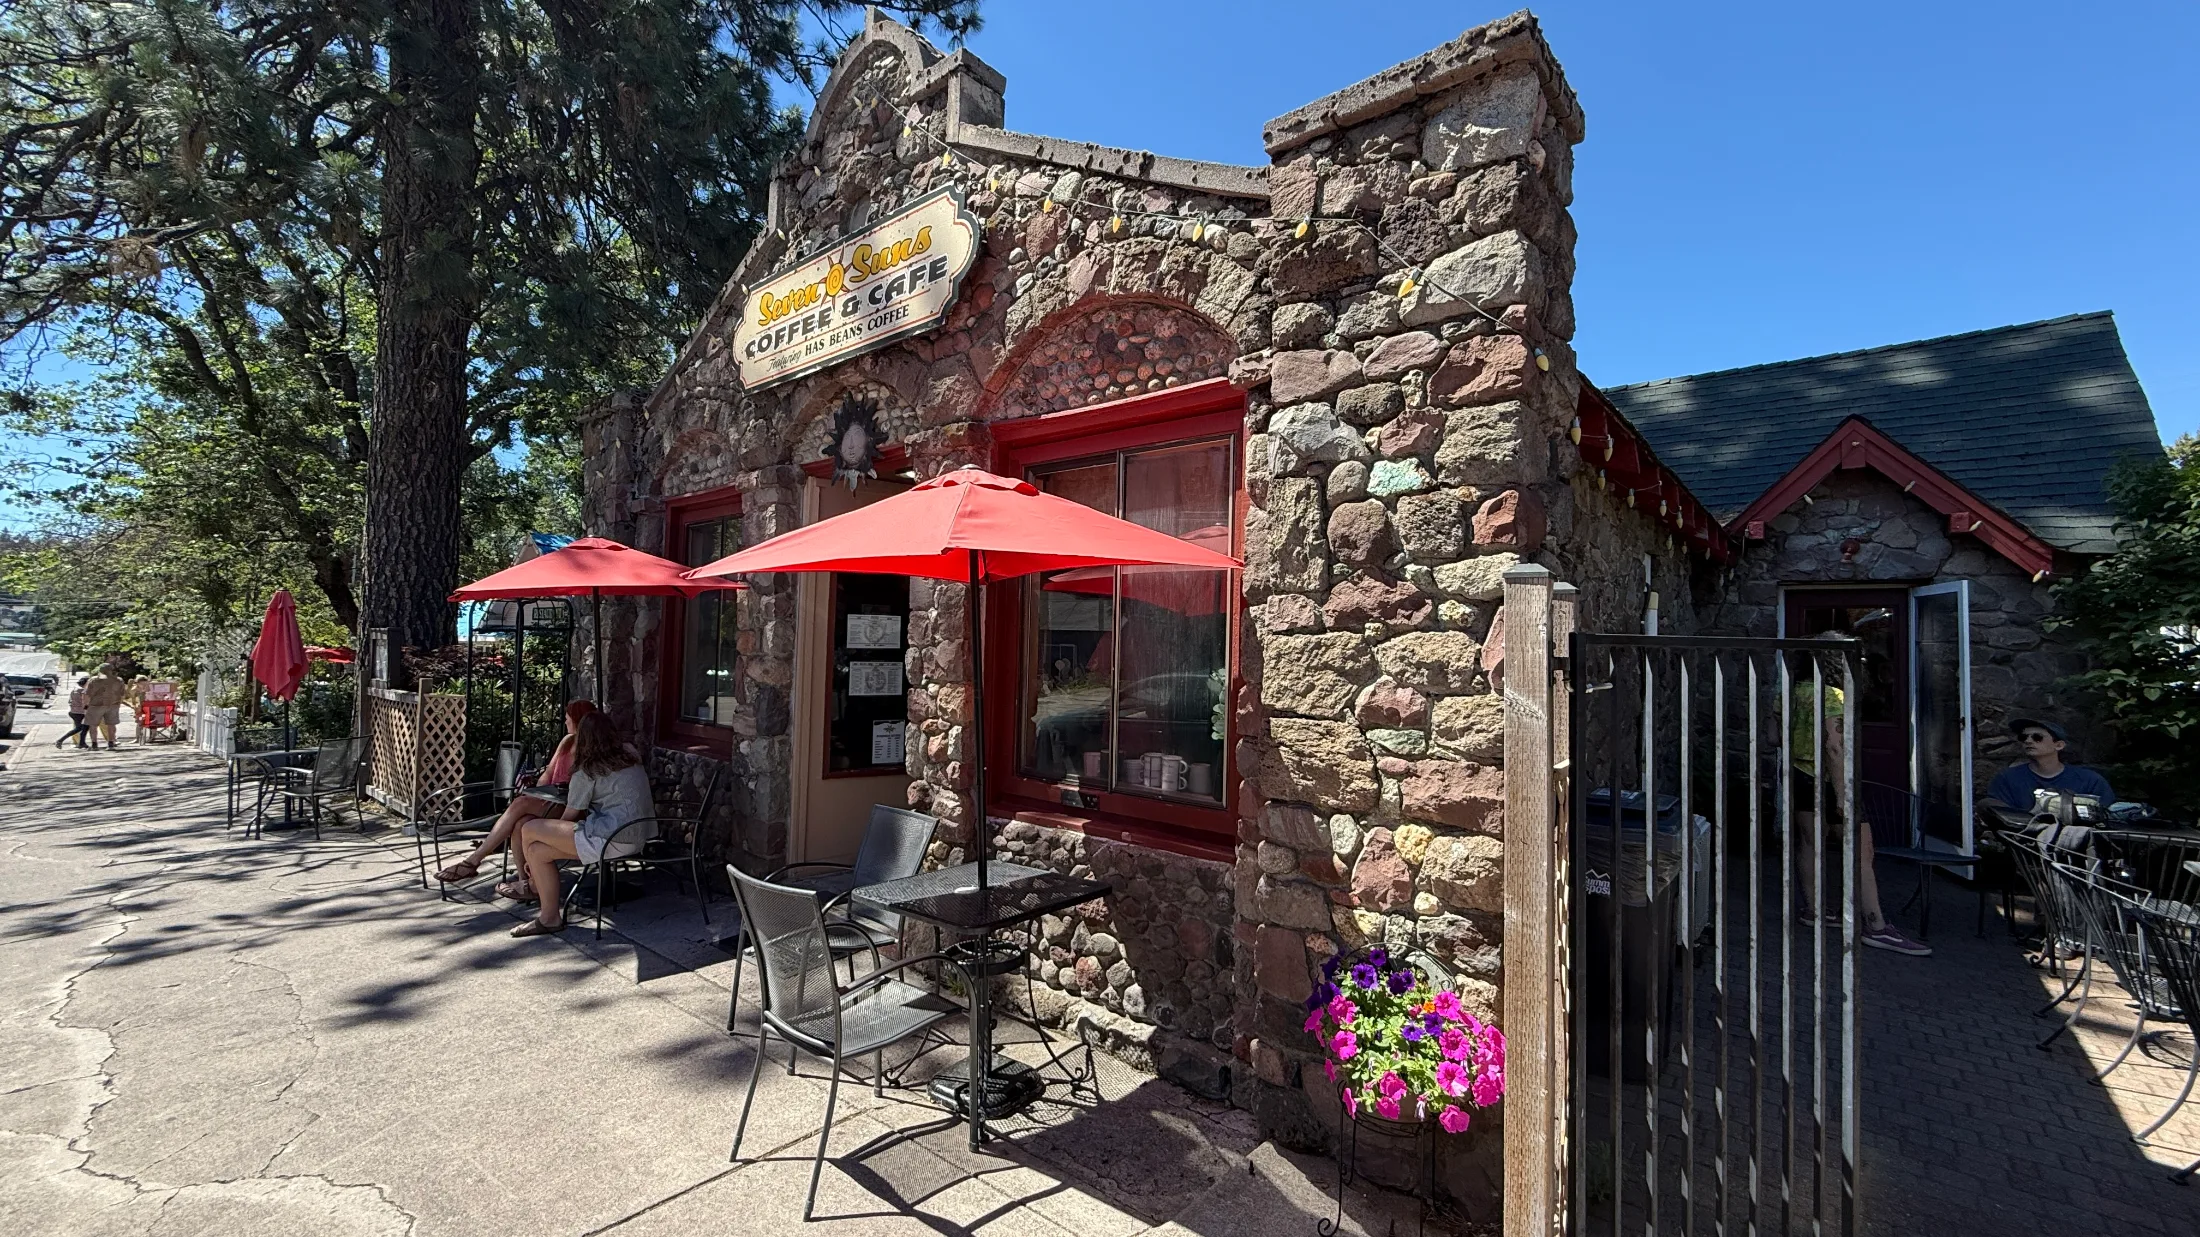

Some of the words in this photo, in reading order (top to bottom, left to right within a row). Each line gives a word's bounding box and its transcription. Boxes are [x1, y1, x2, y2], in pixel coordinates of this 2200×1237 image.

[745, 306, 832, 357] COFFEE
[841, 295, 860, 318] &
[868, 255, 947, 304] CAFE
[758, 283, 821, 326] Seven
[849, 225, 932, 283] Suns
[767, 350, 802, 372] Featuring
[805, 339, 825, 356] HAS
[829, 323, 863, 346] BEANS
[867, 304, 909, 331] COFFEE
